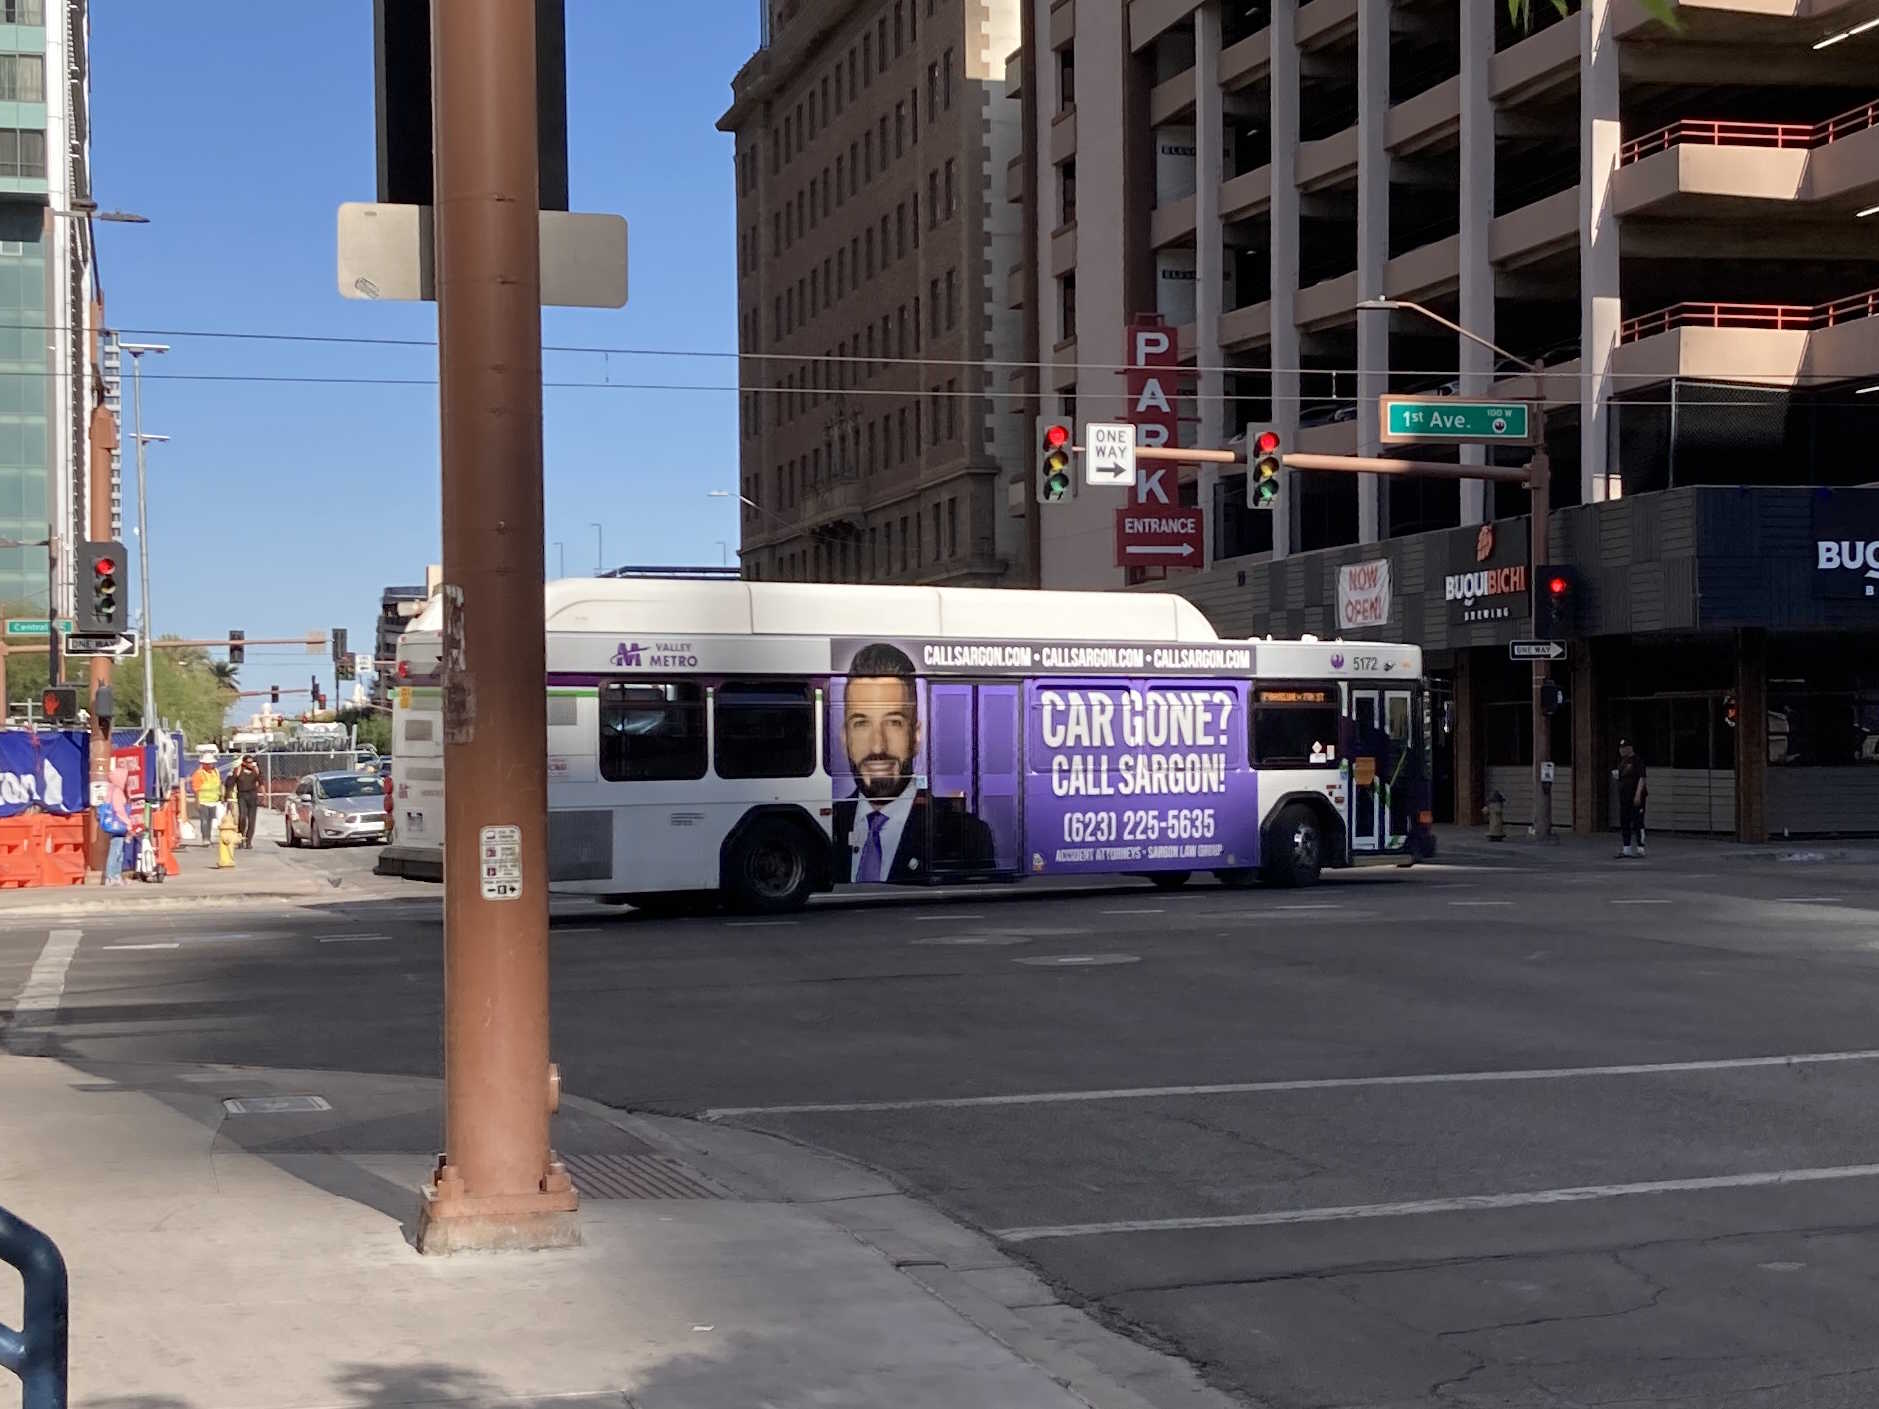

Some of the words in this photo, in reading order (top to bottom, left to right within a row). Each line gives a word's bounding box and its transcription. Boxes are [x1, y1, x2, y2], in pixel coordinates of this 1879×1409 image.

[1136, 332, 1170, 504] PARK
[1403, 410, 1424, 428] 1st
[1429, 411, 1471, 428] Ave.
[1505, 409, 1513, 417] W
[1096, 430, 1127, 443] ONE
[1095, 445, 1128, 458] WAY
[1125, 518, 1196, 533] ENTRANCE
[1348, 565, 1378, 591] NOW
[72, 639, 90, 648] ONE
[655, 643, 692, 652] VALLEY
[650, 655, 698, 667] METRO
[923, 645, 1032, 667] CALLSARGON.COM
[1041, 647, 1143, 668] CALLSARGON.COM
[1153, 648, 1250, 669] CALLSARGON.COM
[1353, 657, 1378, 671] 5172
[1041, 690, 1115, 747] CAR
[1121, 690, 1233, 747] GONE?
[1051, 754, 1114, 796] CALL
[1118, 753, 1226, 795] SARGON!
[1063, 811, 1117, 842] (623)
[1122, 809, 1215, 840] 225-5635
